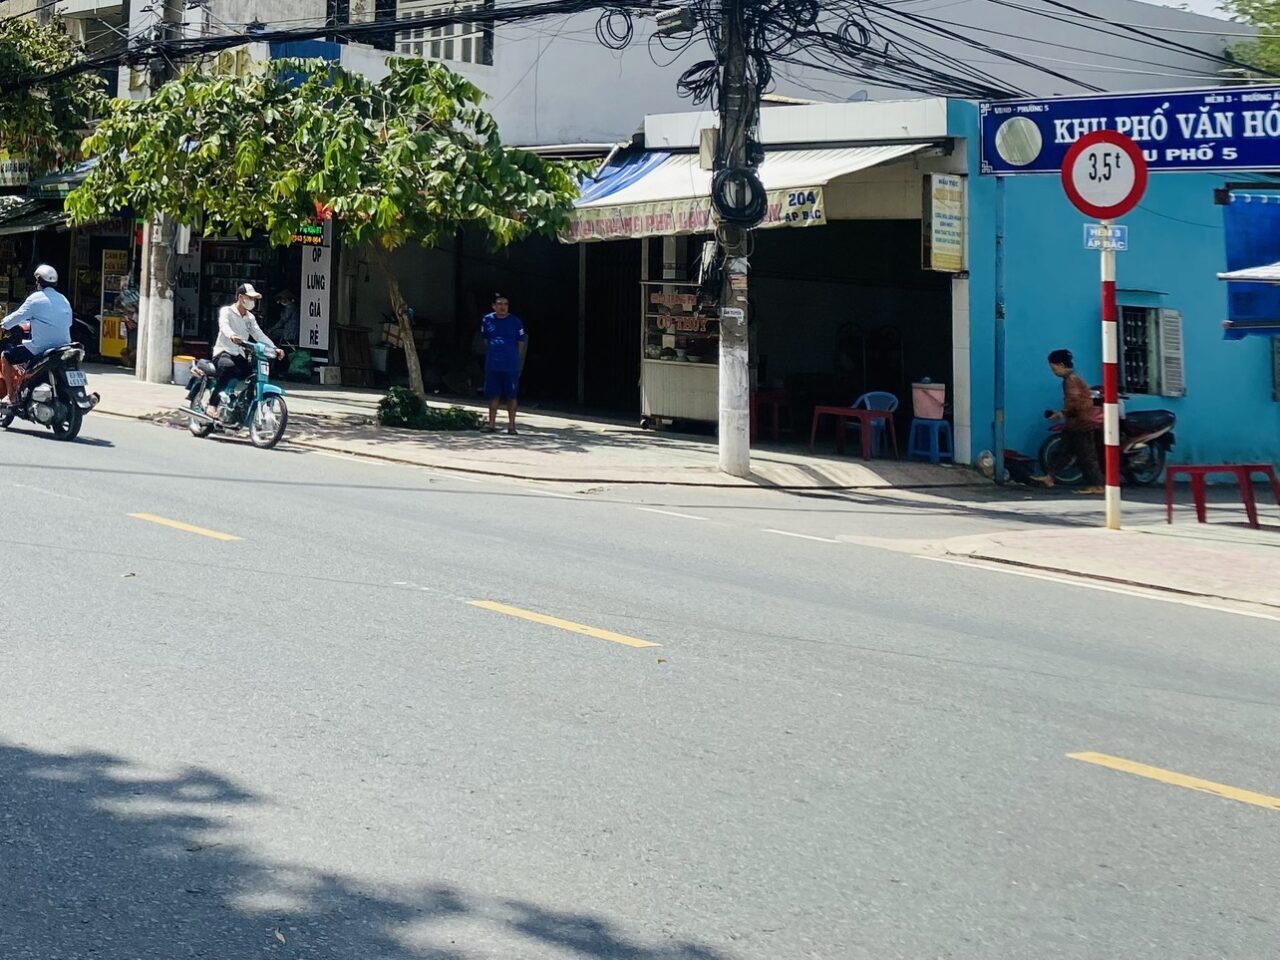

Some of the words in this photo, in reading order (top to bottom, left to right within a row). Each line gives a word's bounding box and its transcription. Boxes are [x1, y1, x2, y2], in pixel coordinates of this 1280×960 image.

[1115, 102, 1170, 141] PHỐ
[1176, 105, 1234, 139] VĂN
[1166, 142, 1216, 162] PHỐ
[1222, 147, 1238, 160] 5
[788, 191, 817, 206] 204
[308, 297, 321, 318] GIÁ
